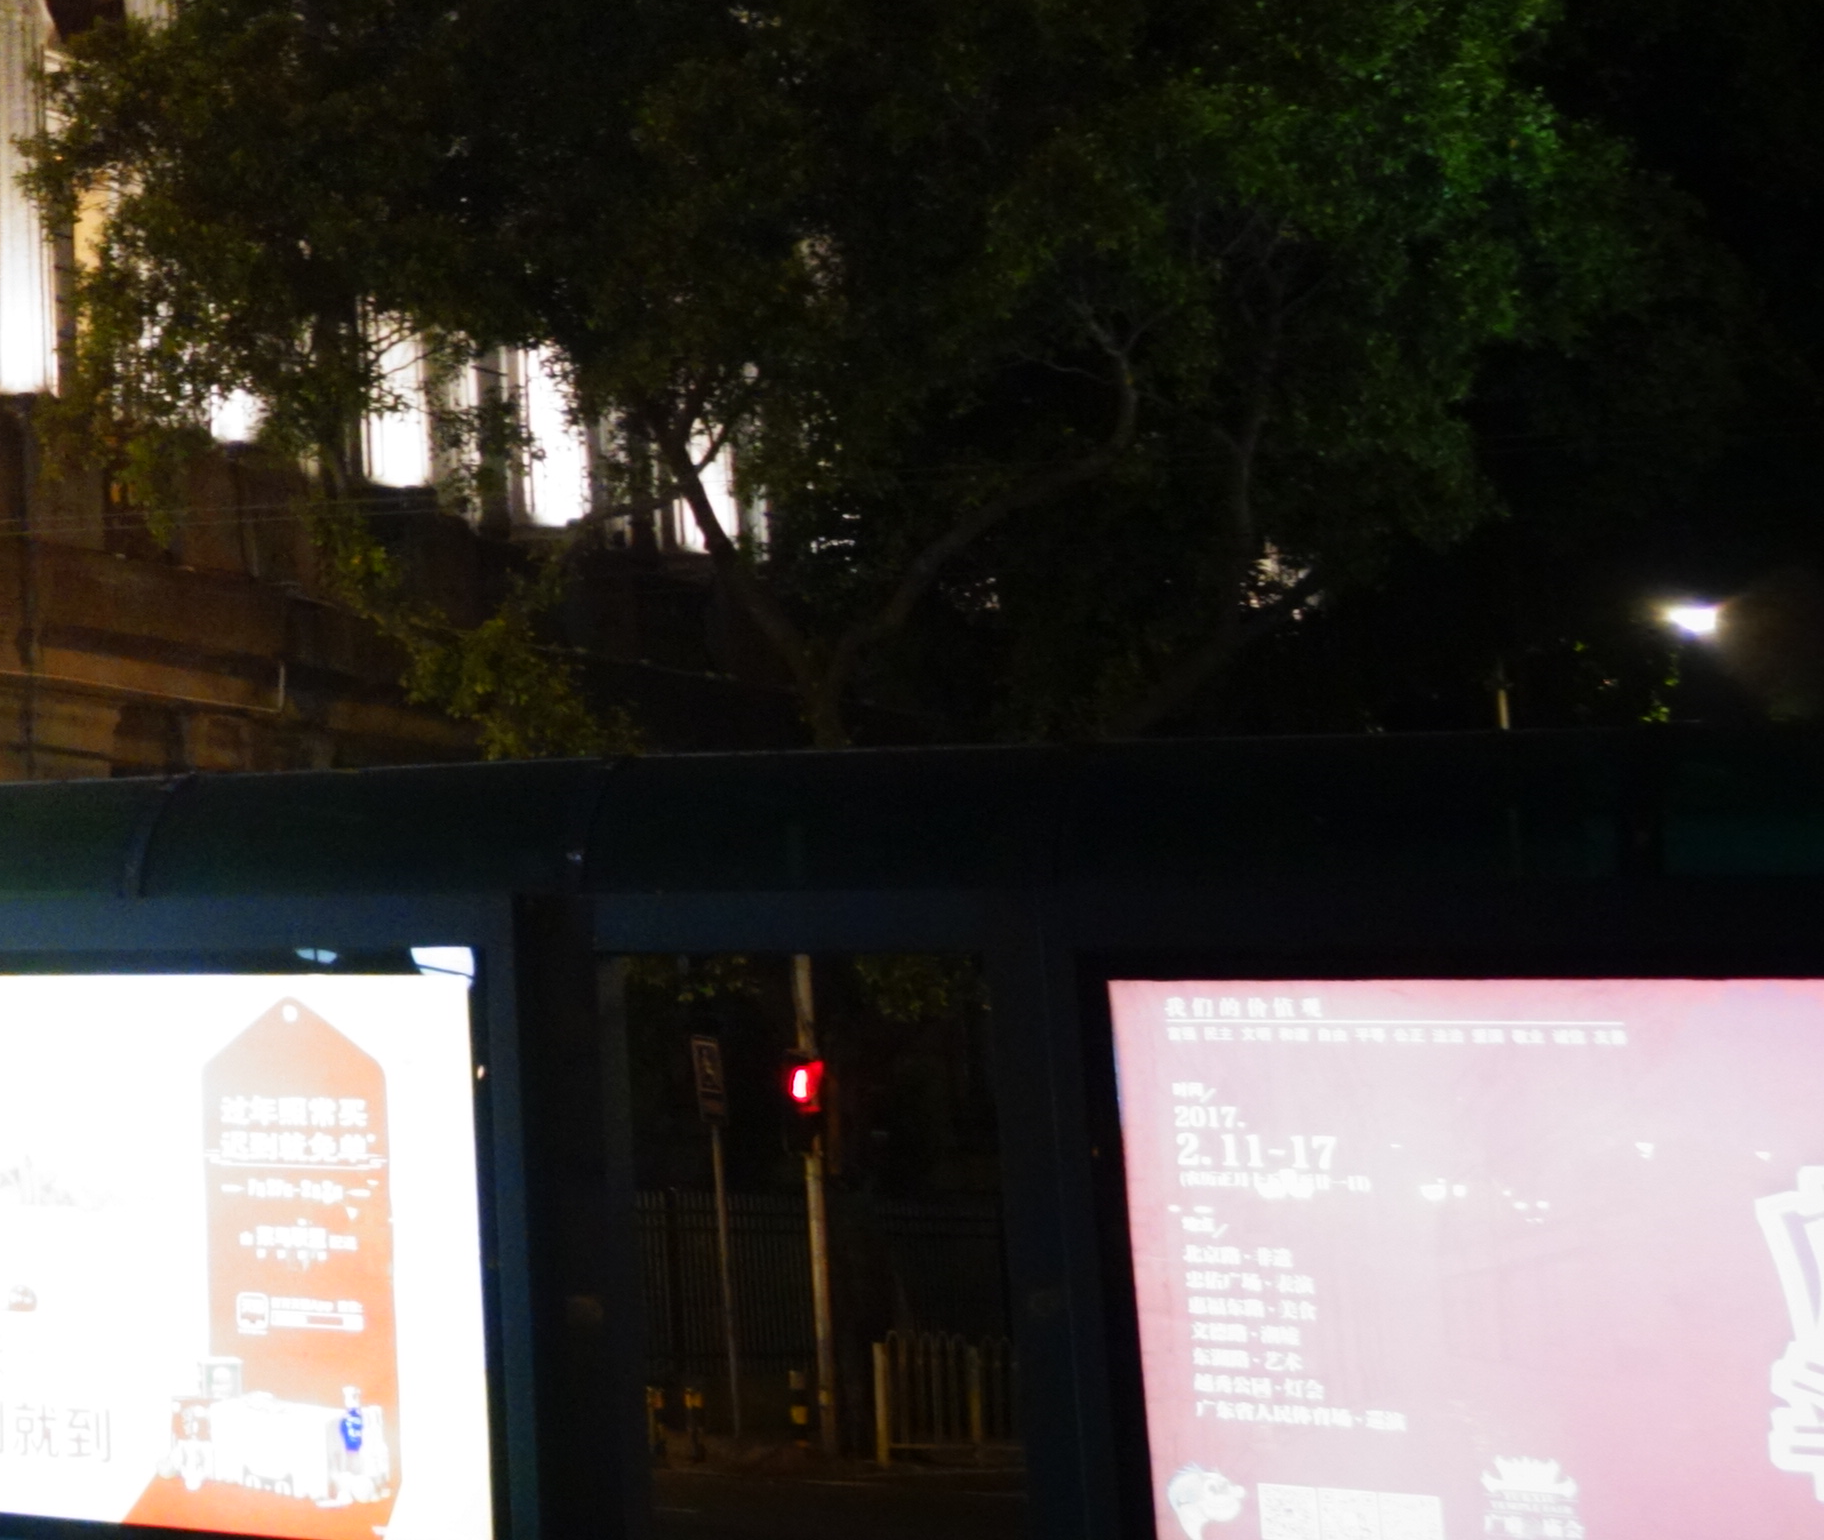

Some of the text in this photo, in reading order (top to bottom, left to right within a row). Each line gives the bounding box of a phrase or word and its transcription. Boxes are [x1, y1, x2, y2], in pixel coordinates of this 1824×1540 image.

[1164, 996, 1324, 1019] 我们的价值观
[220, 1095, 368, 1127] 过年照常买
[1174, 1105, 1247, 1128] 2017.
[1176, 1132, 1338, 1170] 2.11-17
